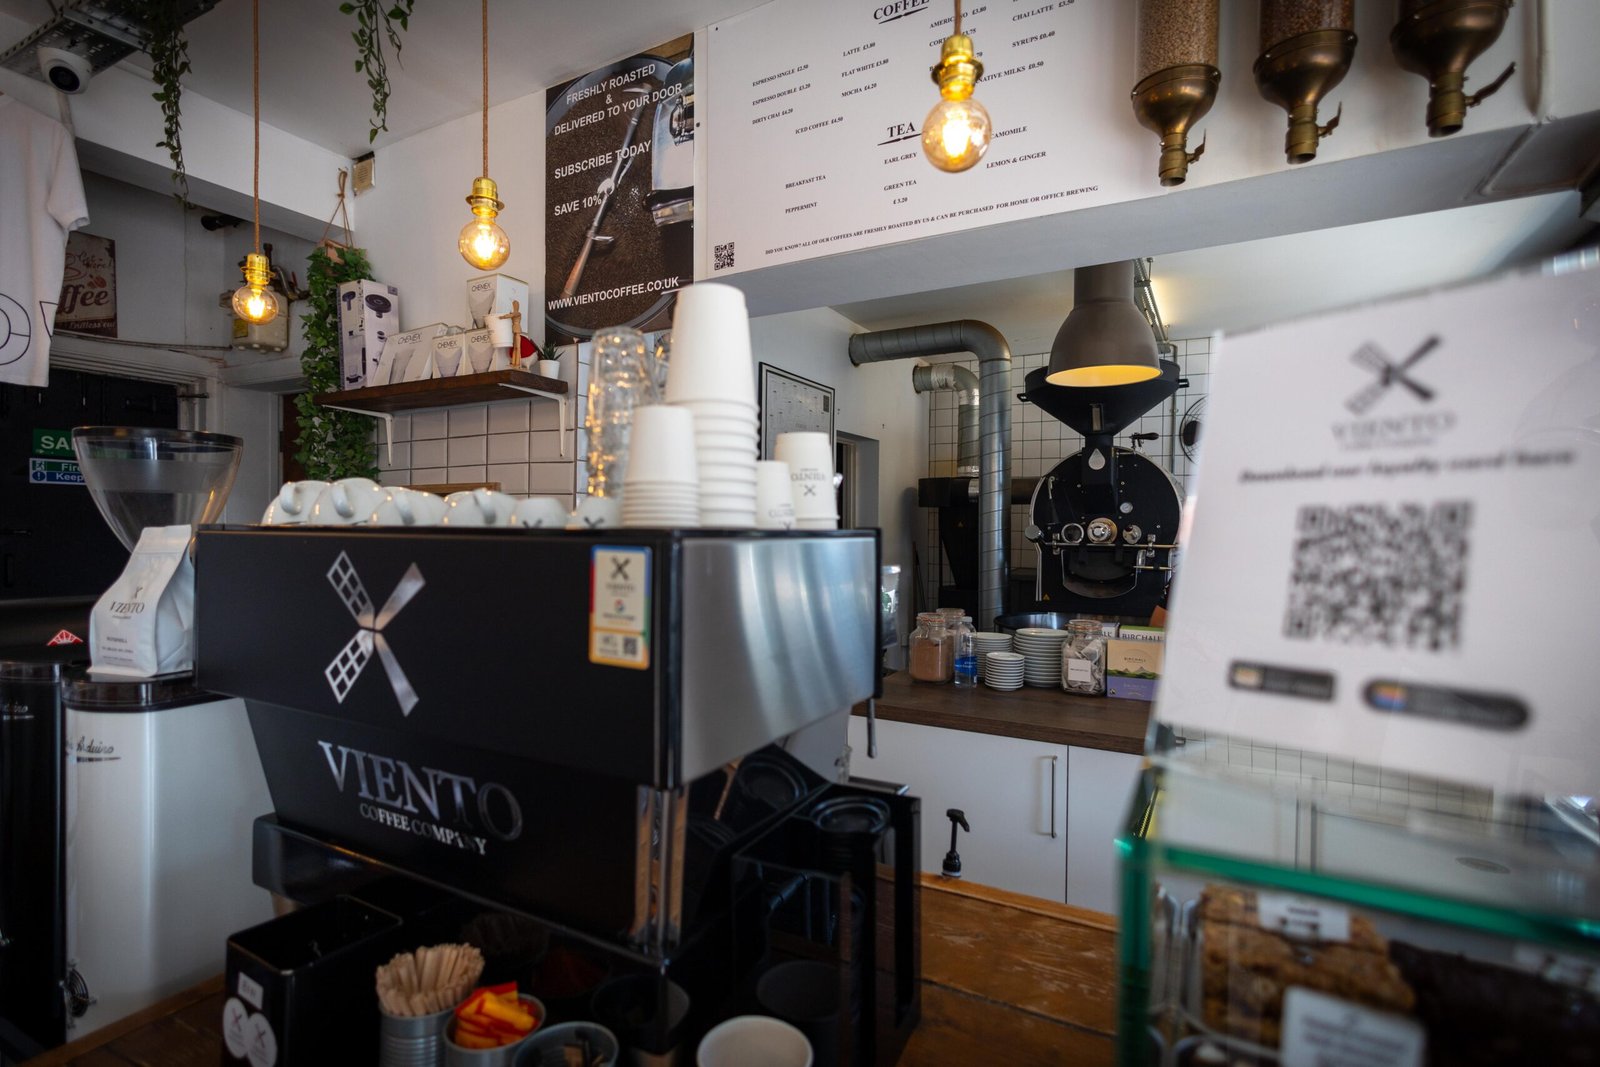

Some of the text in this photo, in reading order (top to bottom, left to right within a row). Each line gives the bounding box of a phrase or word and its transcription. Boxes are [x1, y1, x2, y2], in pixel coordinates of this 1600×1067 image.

[1012, 12, 1030, 21] CHAI
[1031, 4, 1054, 16] LATTE
[1012, 30, 1056, 48] SYRUPS £0.40
[842, 46, 861, 57] LATTE
[752, 75, 776, 87] ESPRESSO
[776, 68, 796, 78] SINGLE
[841, 68, 856, 78] FLAT
[856, 62, 875, 73] WHITE
[1003, 66, 1026, 77] MILKS
[566, 64, 656, 105] FRESHLY ROASTED
[605, 94, 613, 104] &
[752, 94, 776, 106] ESPRESSO
[776, 87, 798, 98] DOUBLE
[841, 88, 862, 98] MOCHA
[554, 83, 683, 136] DELIVERED TO YOUR DOOR
[752, 116, 767, 125] DIRTY
[768, 111, 781, 120] CHAI
[795, 126, 808, 135] ICED
[808, 120, 830, 131] COFFEE
[886, 122, 916, 138] TEA
[554, 140, 653, 180] SUBSCRIBE TODAY
[884, 152, 918, 165] EARL GREY
[986, 152, 1047, 169] LEMON & GINGER
[785, 174, 826, 190] BREAKFAST TEA
[883, 180, 918, 192] GREEN TEA
[554, 194, 602, 216] SAVE 10%
[784, 202, 818, 214] PEPPERMINT
[830, 232, 853, 242] COFFEES
[864, 226, 887, 235] FRESHLY
[888, 220, 914, 230] ROASTED
[922, 216, 930, 224] US
[958, 205, 994, 217] PURCHASED
[996, 202, 1010, 210] FOR
[1010, 198, 1029, 208] HOME
[1041, 191, 1066, 201] OFFICE
[1066, 185, 1099, 196] BREWING
[471, 282, 492, 292] CHEMEX
[548, 276, 680, 312] WWW.VIENTOCOFFEE.CO.UK
[398, 333, 421, 345] CHEMEX
[437, 340, 458, 350] CHEMEX
[317, 740, 523, 842] VIENTO
[359, 803, 488, 856] COFFEE COMPANY
